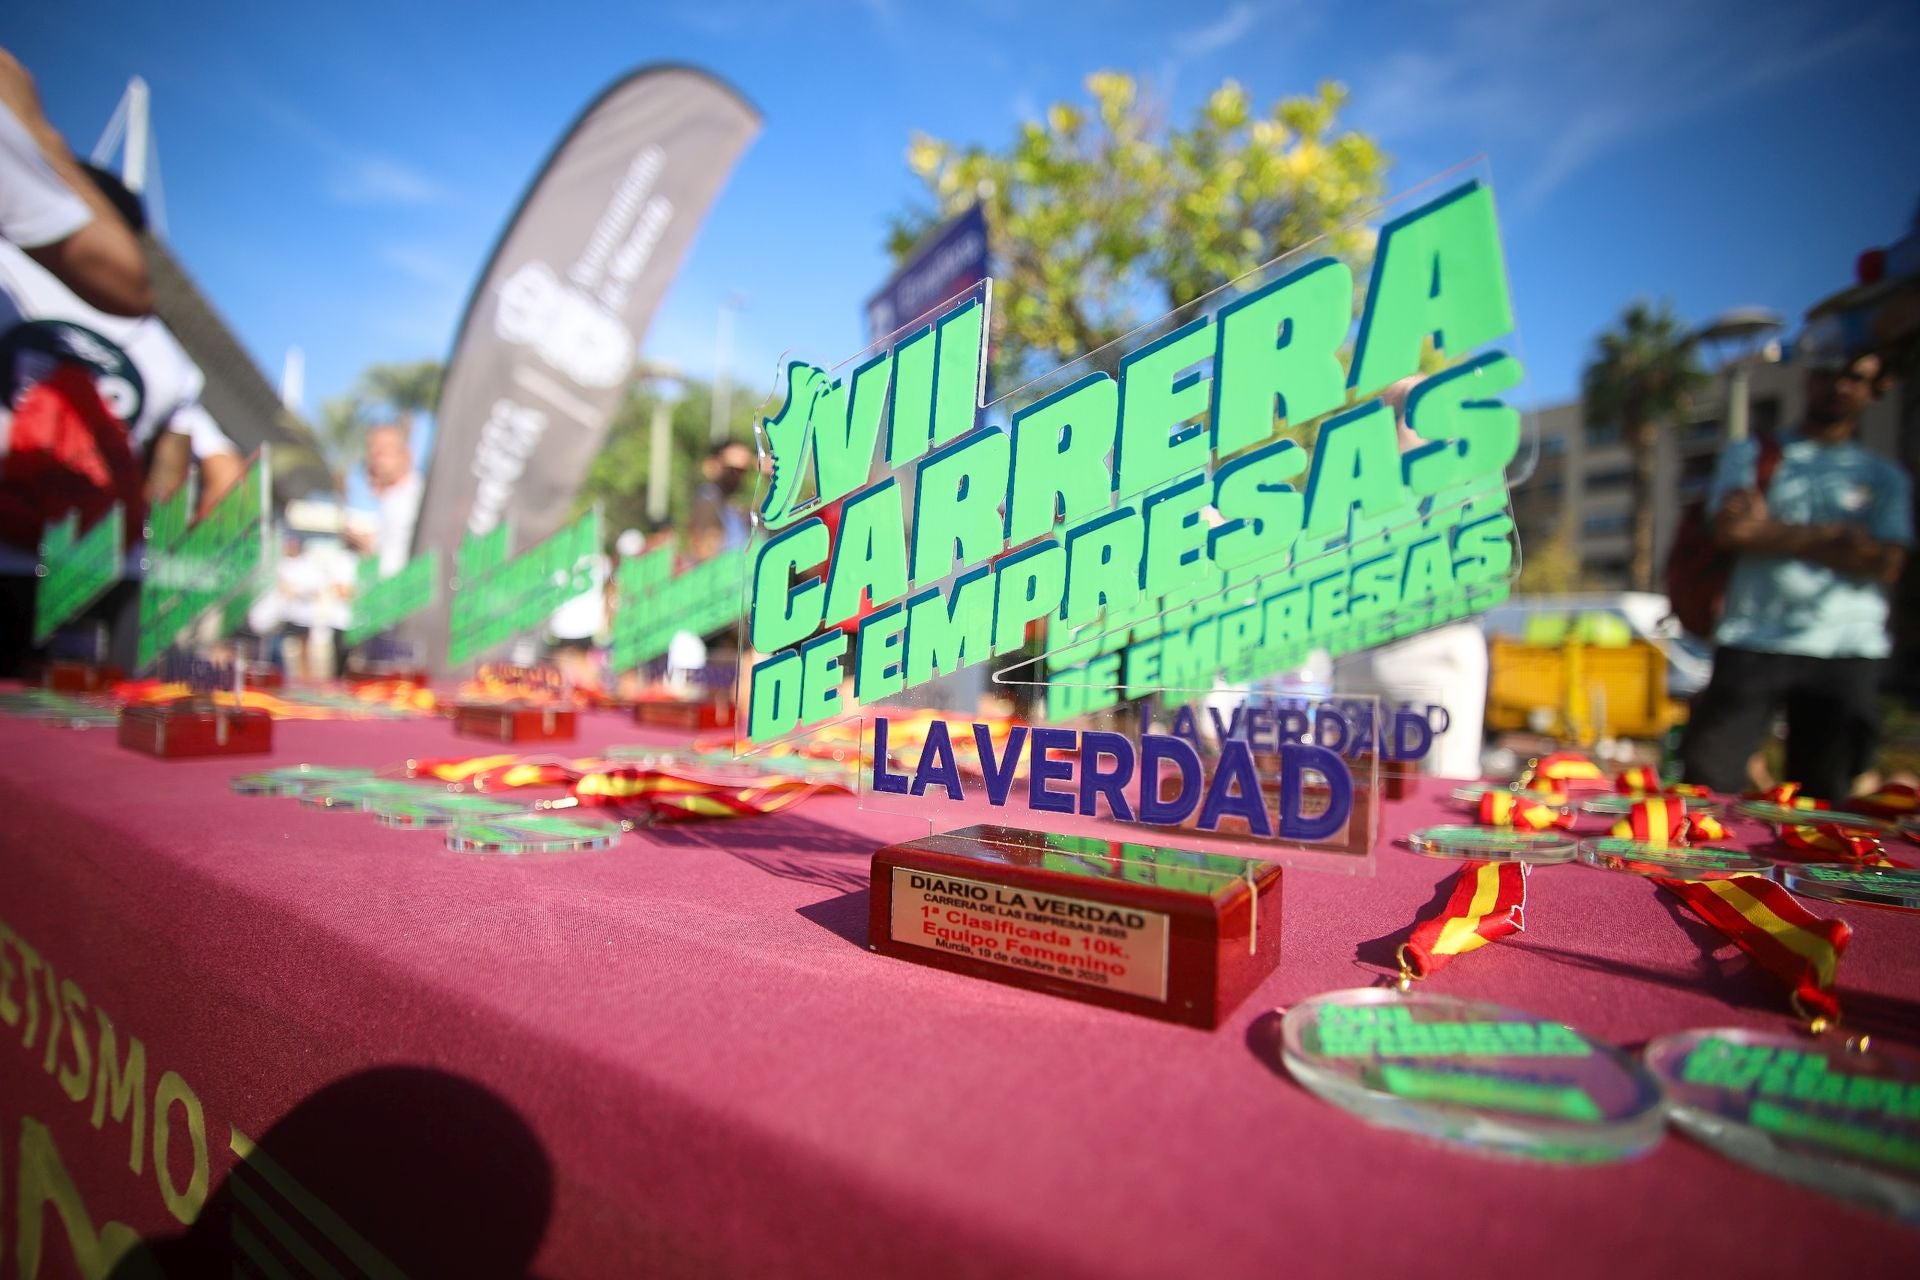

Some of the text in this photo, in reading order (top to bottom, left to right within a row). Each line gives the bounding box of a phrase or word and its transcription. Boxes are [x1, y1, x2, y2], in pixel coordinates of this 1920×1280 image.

[750, 178, 1514, 655] CARRERA
[747, 627, 848, 744] DE
[853, 350, 1524, 706] EMPRESAS
[910, 876, 1144, 929] DIARIO LA VERDAD
[923, 893, 977, 911] CARRERA
[980, 904, 995, 914] DE
[998, 908, 1021, 919] LAS
[1024, 912, 1094, 933] EMPRESAS
[923, 921, 1127, 976] Equipo Femenino
[935, 938, 974, 956] Murcia,
[978, 947, 991, 958] 19
[994, 951, 1008, 961] de
[1011, 955, 1055, 971] octubre
[1058, 965, 1073, 976] de
[946, 910, 1071, 946] Clasificada
[1081, 936, 1131, 959] 10k.
